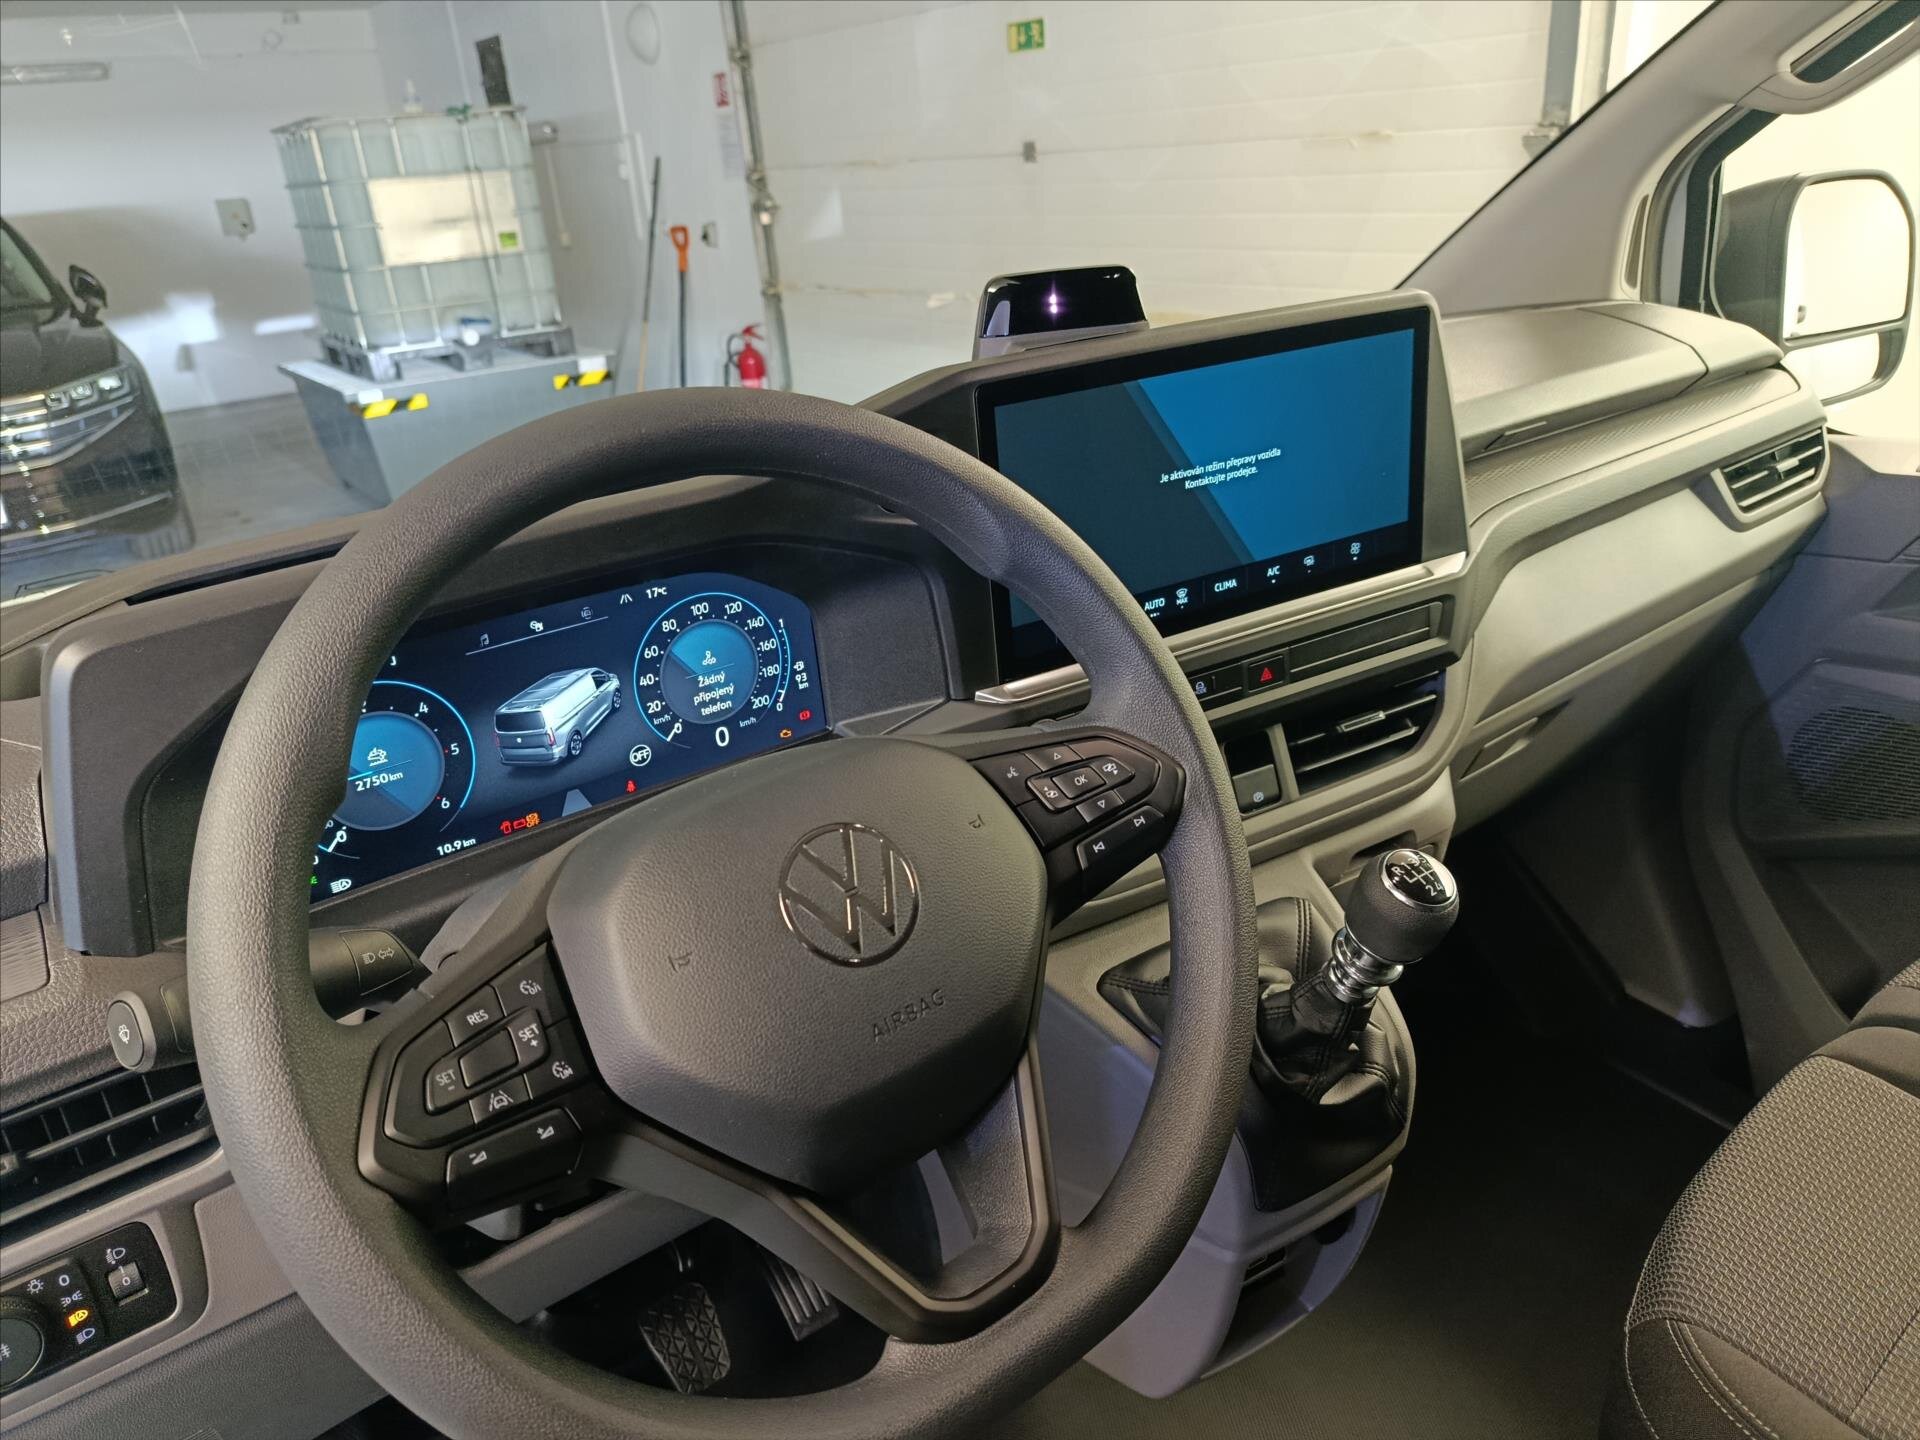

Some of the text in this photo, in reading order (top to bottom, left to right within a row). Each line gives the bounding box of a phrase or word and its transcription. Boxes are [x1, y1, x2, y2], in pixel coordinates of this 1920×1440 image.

[1160, 447, 1281, 483] Je aktivován režim přepravy vozidla
[1185, 466, 1258, 489] Kontaktujte prodejce.
[1266, 565, 1280, 577] A/C
[1214, 579, 1237, 592] CLIMA
[690, 602, 709, 616] 100
[724, 601, 742, 615] 120
[1144, 597, 1165, 611] AUTO
[661, 619, 677, 632] 80
[746, 616, 765, 630] 140
[644, 645, 659, 659] 60
[759, 638, 777, 652] 160
[761, 664, 780, 678] 180
[795, 672, 807, 683] 93
[639, 673, 655, 687] 40
[698, 671, 726, 687] Žádný
[693, 683, 735, 706] připojený
[752, 694, 770, 709] 200
[419, 702, 429, 713] 4
[646, 700, 662, 714] 20
[701, 700, 732, 716] telefon
[776, 702, 783, 712] 0
[739, 716, 757, 728] km/h
[715, 726, 730, 747] 0
[450, 742, 460, 755] 5
[632, 748, 650, 762] OFF
[1074, 774, 1089, 786] OK
[441, 797, 450, 809] 6
[437, 838, 476, 856] 10.9 km
[1391, 866, 1405, 876] R
[1425, 885, 1437, 896] 2
[466, 1009, 489, 1026] RES
[872, 988, 946, 1043] AIRBAG
[518, 1023, 539, 1042] SET
[435, 1069, 457, 1086] SET
